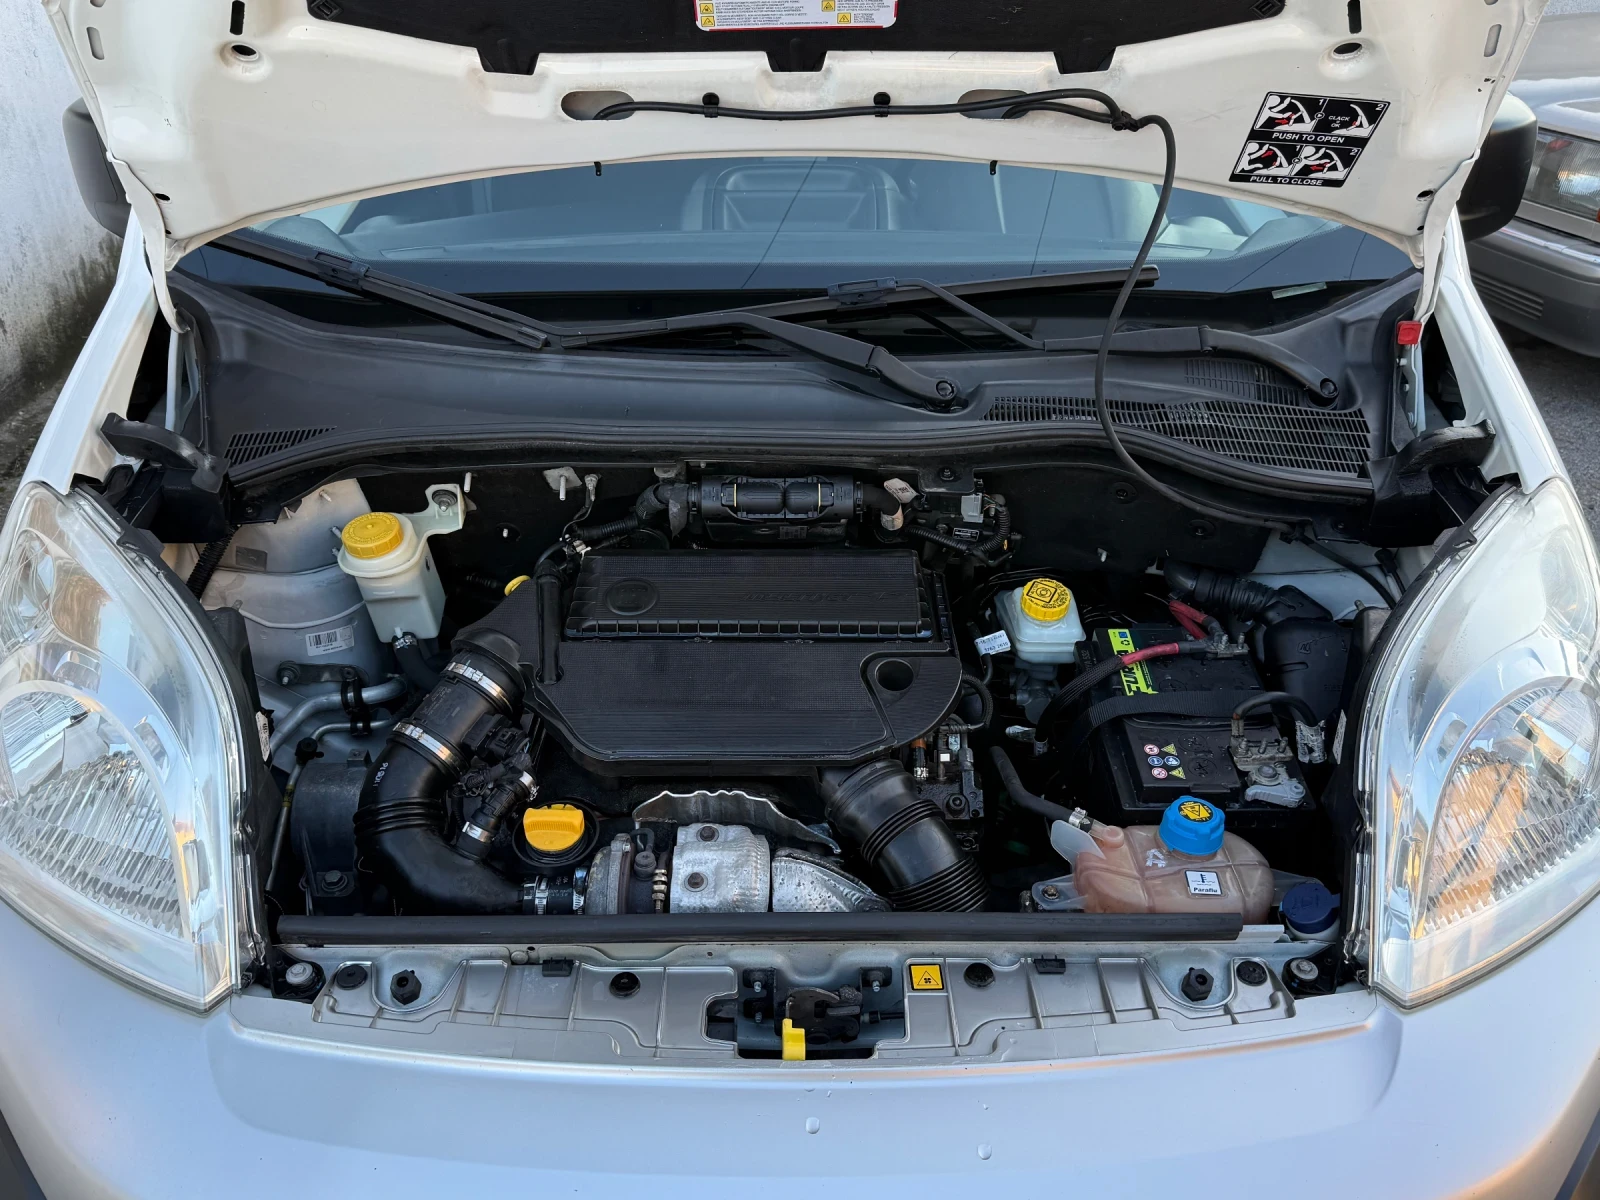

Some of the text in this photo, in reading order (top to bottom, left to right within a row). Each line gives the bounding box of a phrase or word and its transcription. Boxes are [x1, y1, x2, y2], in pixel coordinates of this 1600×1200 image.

[1272, 132, 1300, 140] PUSH
[1317, 135, 1345, 144] OPEN
[1291, 178, 1324, 186] CLOSE
